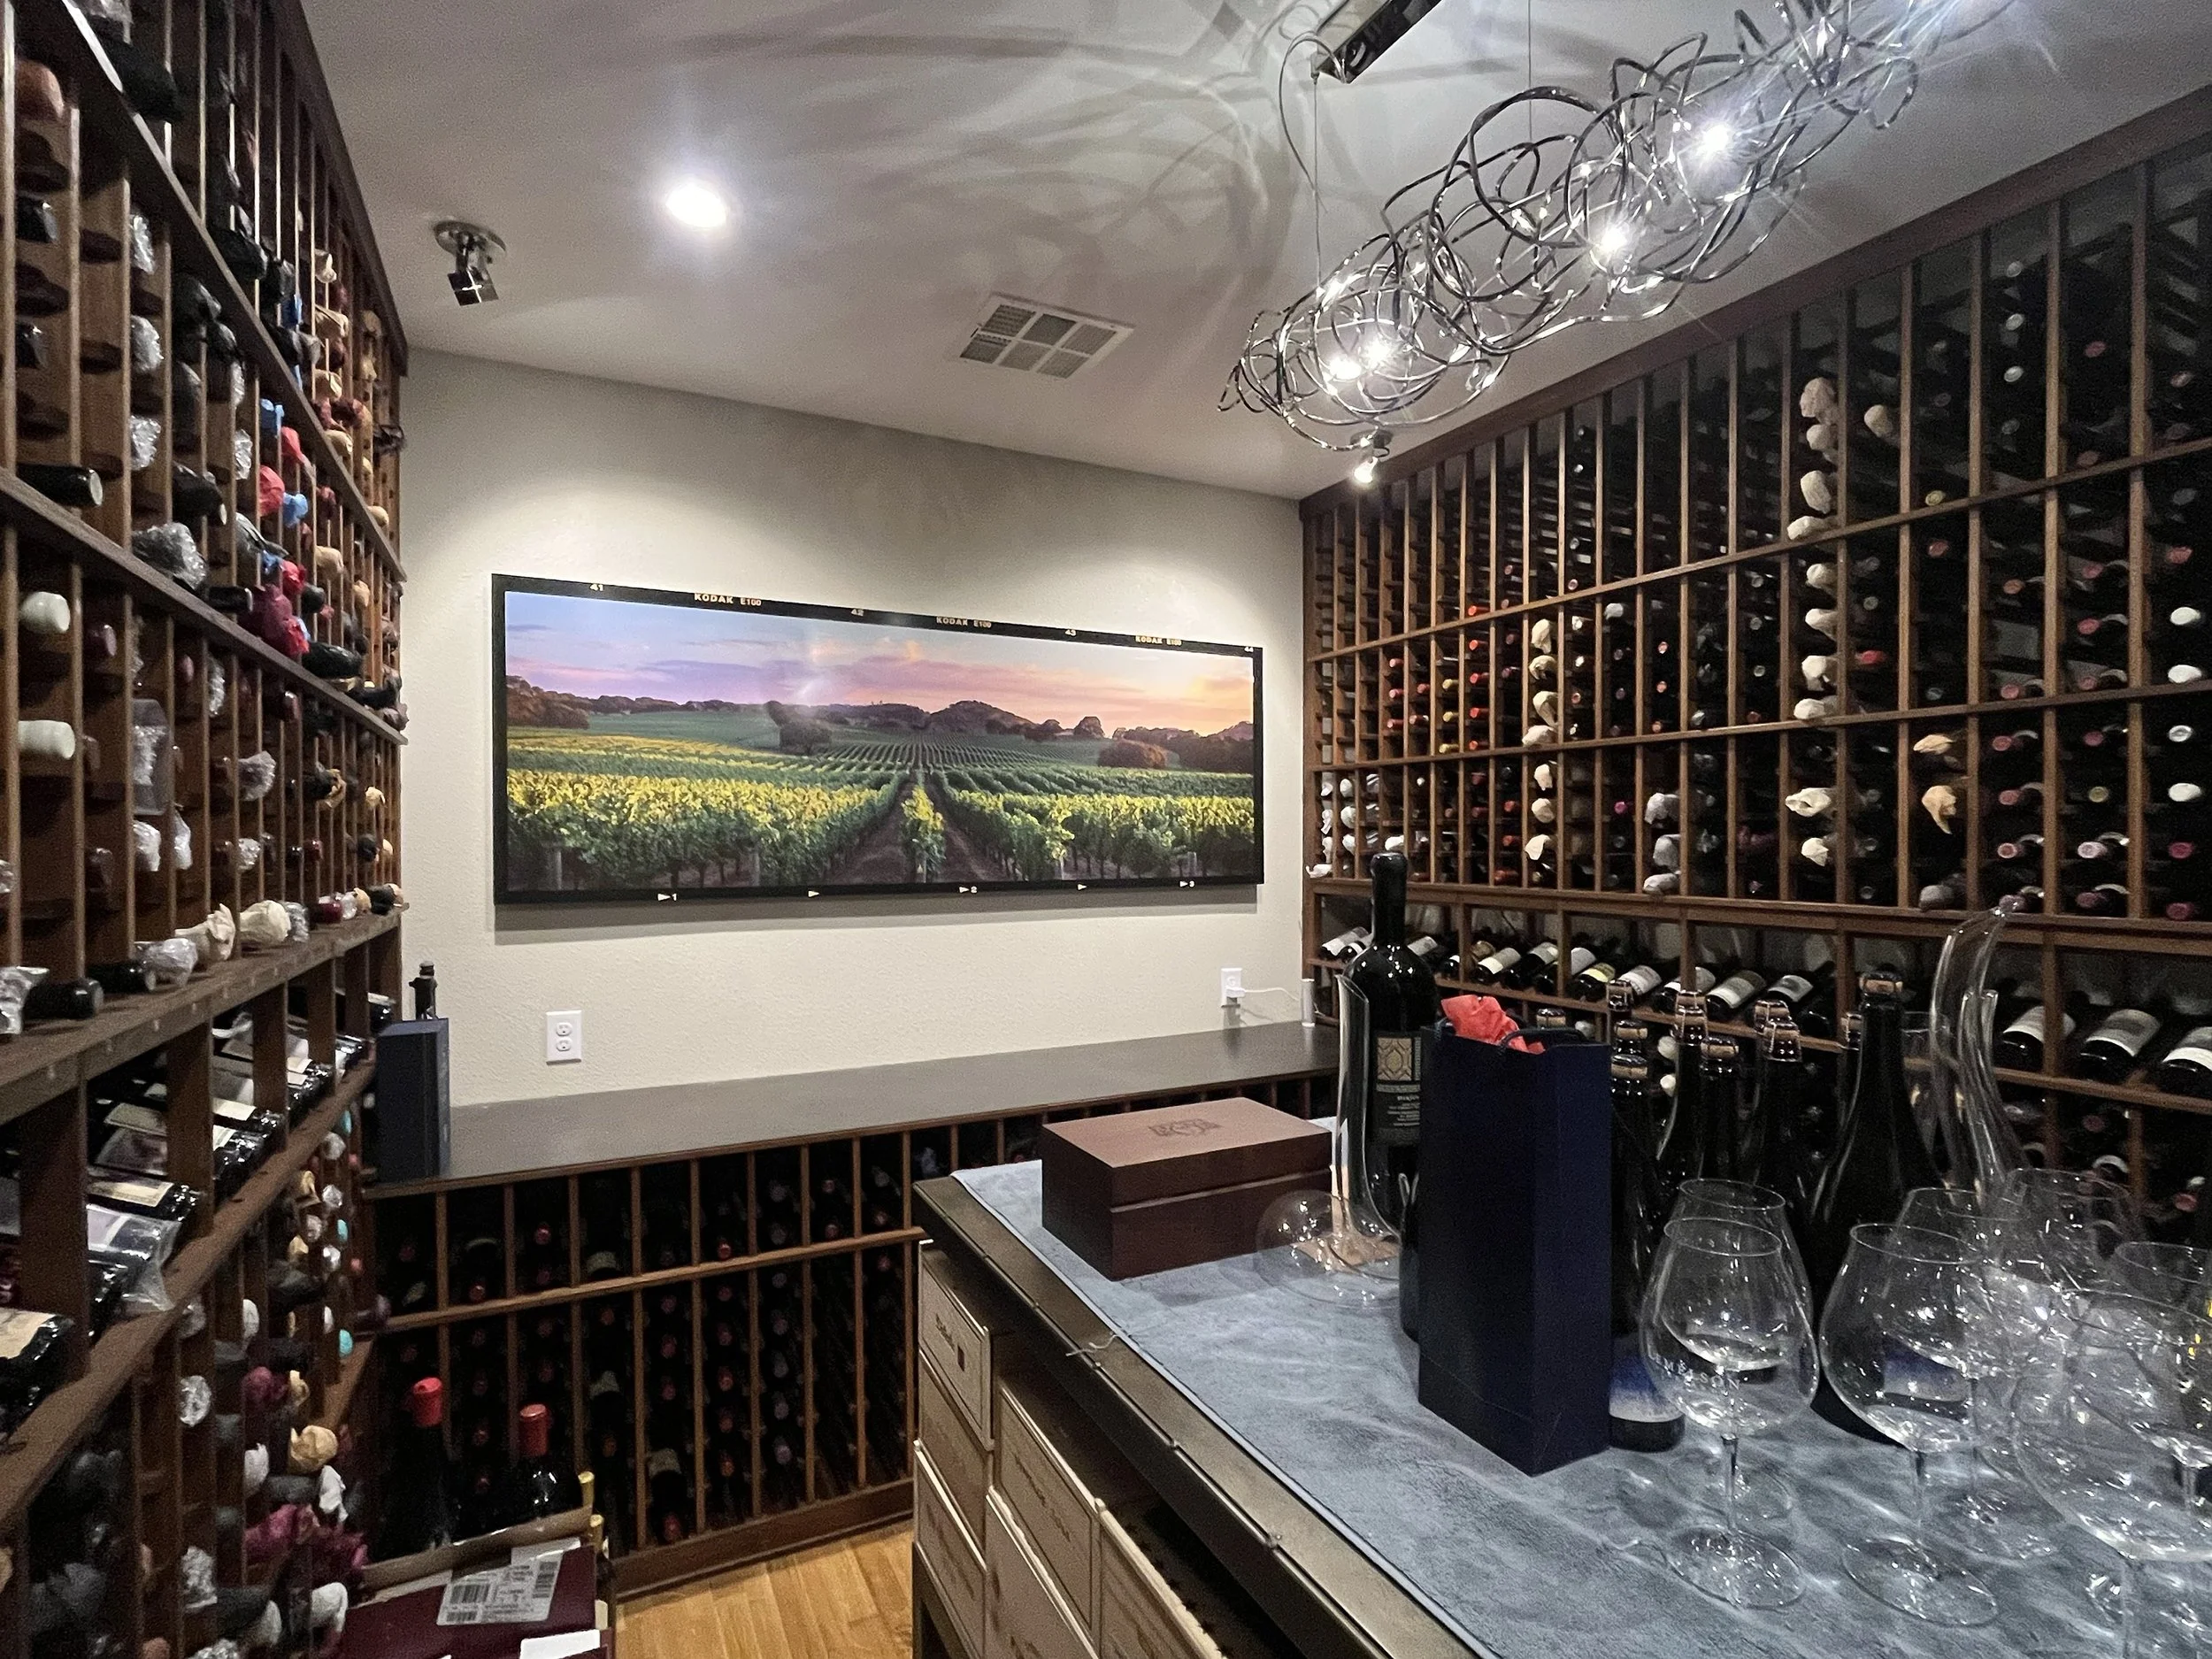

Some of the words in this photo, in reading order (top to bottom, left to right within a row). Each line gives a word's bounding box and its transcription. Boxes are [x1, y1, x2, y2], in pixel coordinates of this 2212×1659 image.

[589, 583, 603, 592] 41
[694, 593, 733, 604] KODAK
[740, 597, 762, 606] E100
[936, 617, 968, 626] KODAK
[1135, 635, 1163, 644] KODAK
